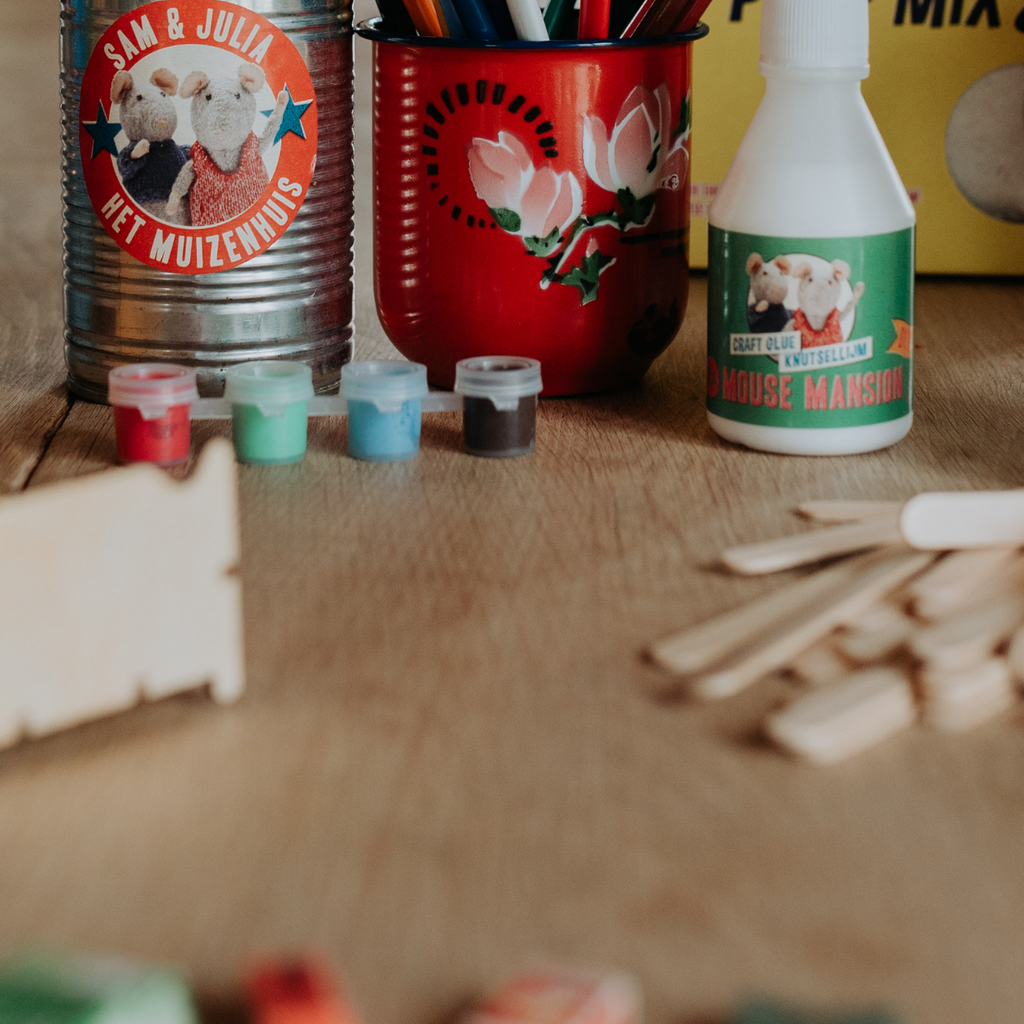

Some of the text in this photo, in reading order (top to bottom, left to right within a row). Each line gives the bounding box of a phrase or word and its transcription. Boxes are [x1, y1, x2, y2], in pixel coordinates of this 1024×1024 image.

[103, 7, 275, 70] SAM & JULIA
[101, 176, 303, 269] HET MUIZENHUIS
[732, 335, 795, 353] CRAFT GLUE
[722, 366, 793, 411] MOUSE
[804, 366, 904, 411] MANSION
